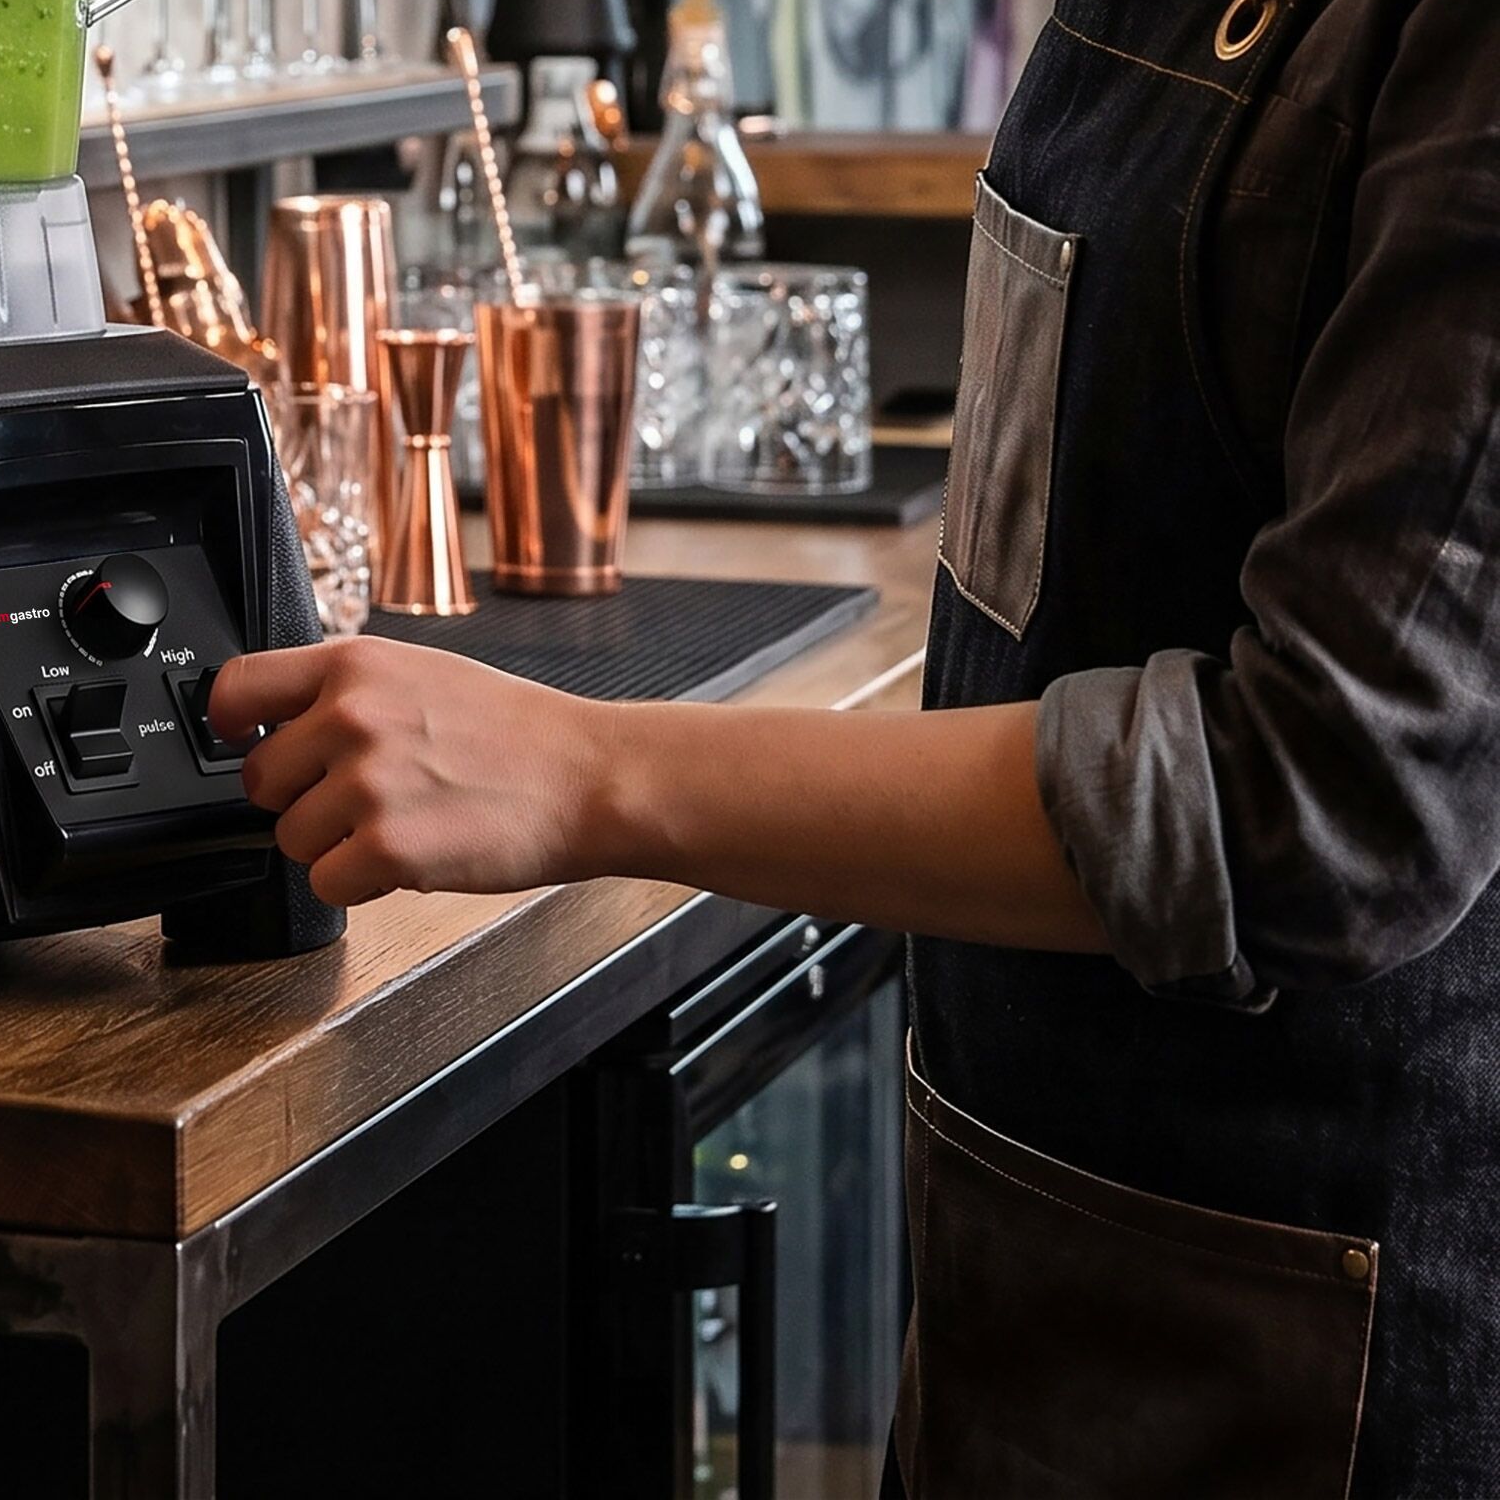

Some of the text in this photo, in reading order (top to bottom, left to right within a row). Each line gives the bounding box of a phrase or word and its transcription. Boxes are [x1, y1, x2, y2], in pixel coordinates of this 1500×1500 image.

[160, 646, 196, 666] High
[41, 664, 71, 679] Low
[12, 704, 33, 719] on
[138, 718, 175, 738] pulse
[34, 760, 56, 778] off
